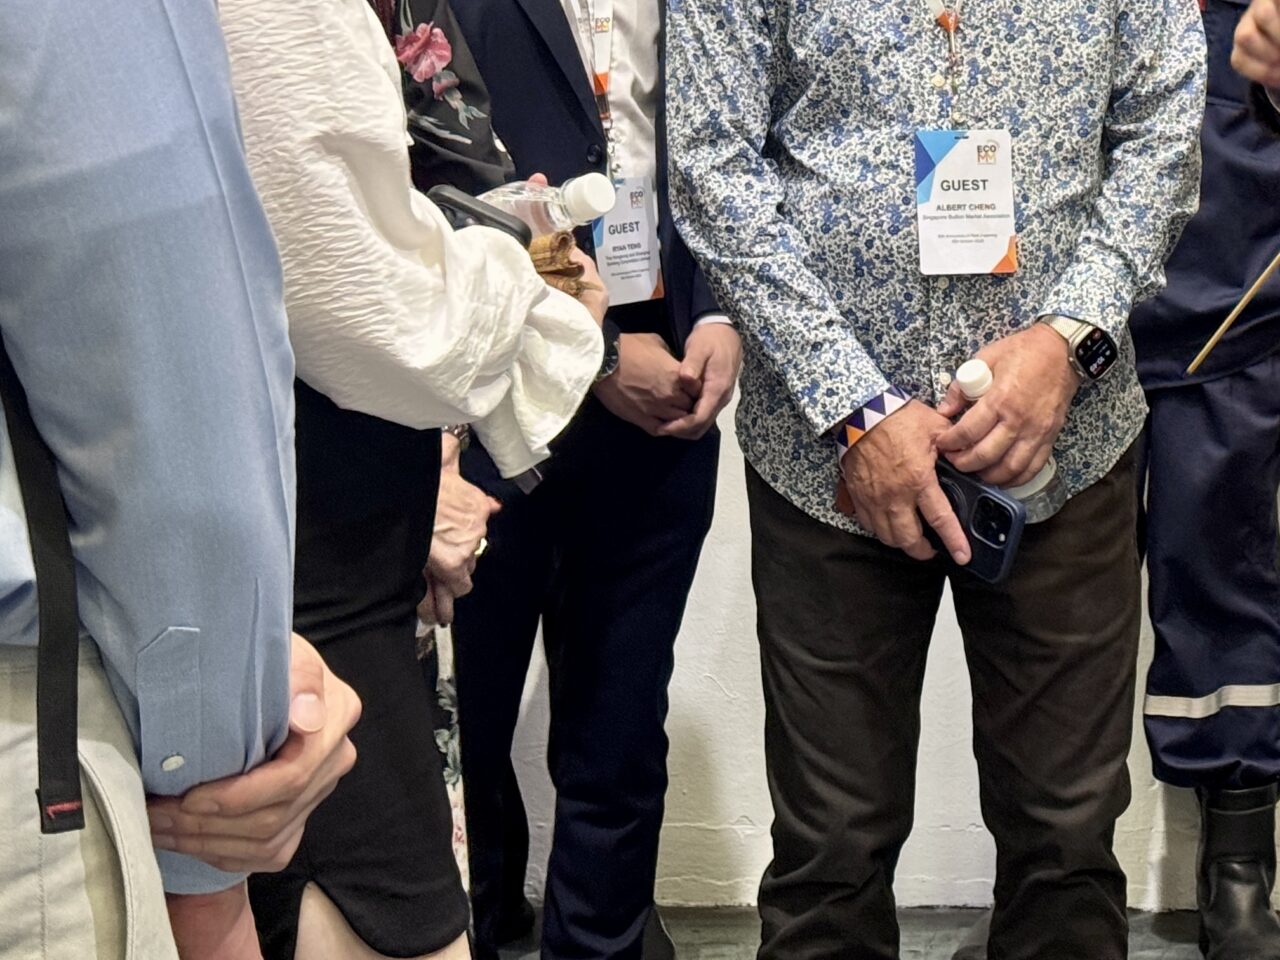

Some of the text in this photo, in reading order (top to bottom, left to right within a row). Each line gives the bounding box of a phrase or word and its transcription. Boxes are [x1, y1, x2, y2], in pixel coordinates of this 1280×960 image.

[977, 145, 996, 153] ECO
[940, 180, 988, 191] GUEST
[969, 203, 996, 211] CHENG
[608, 221, 640, 235] GUEST
